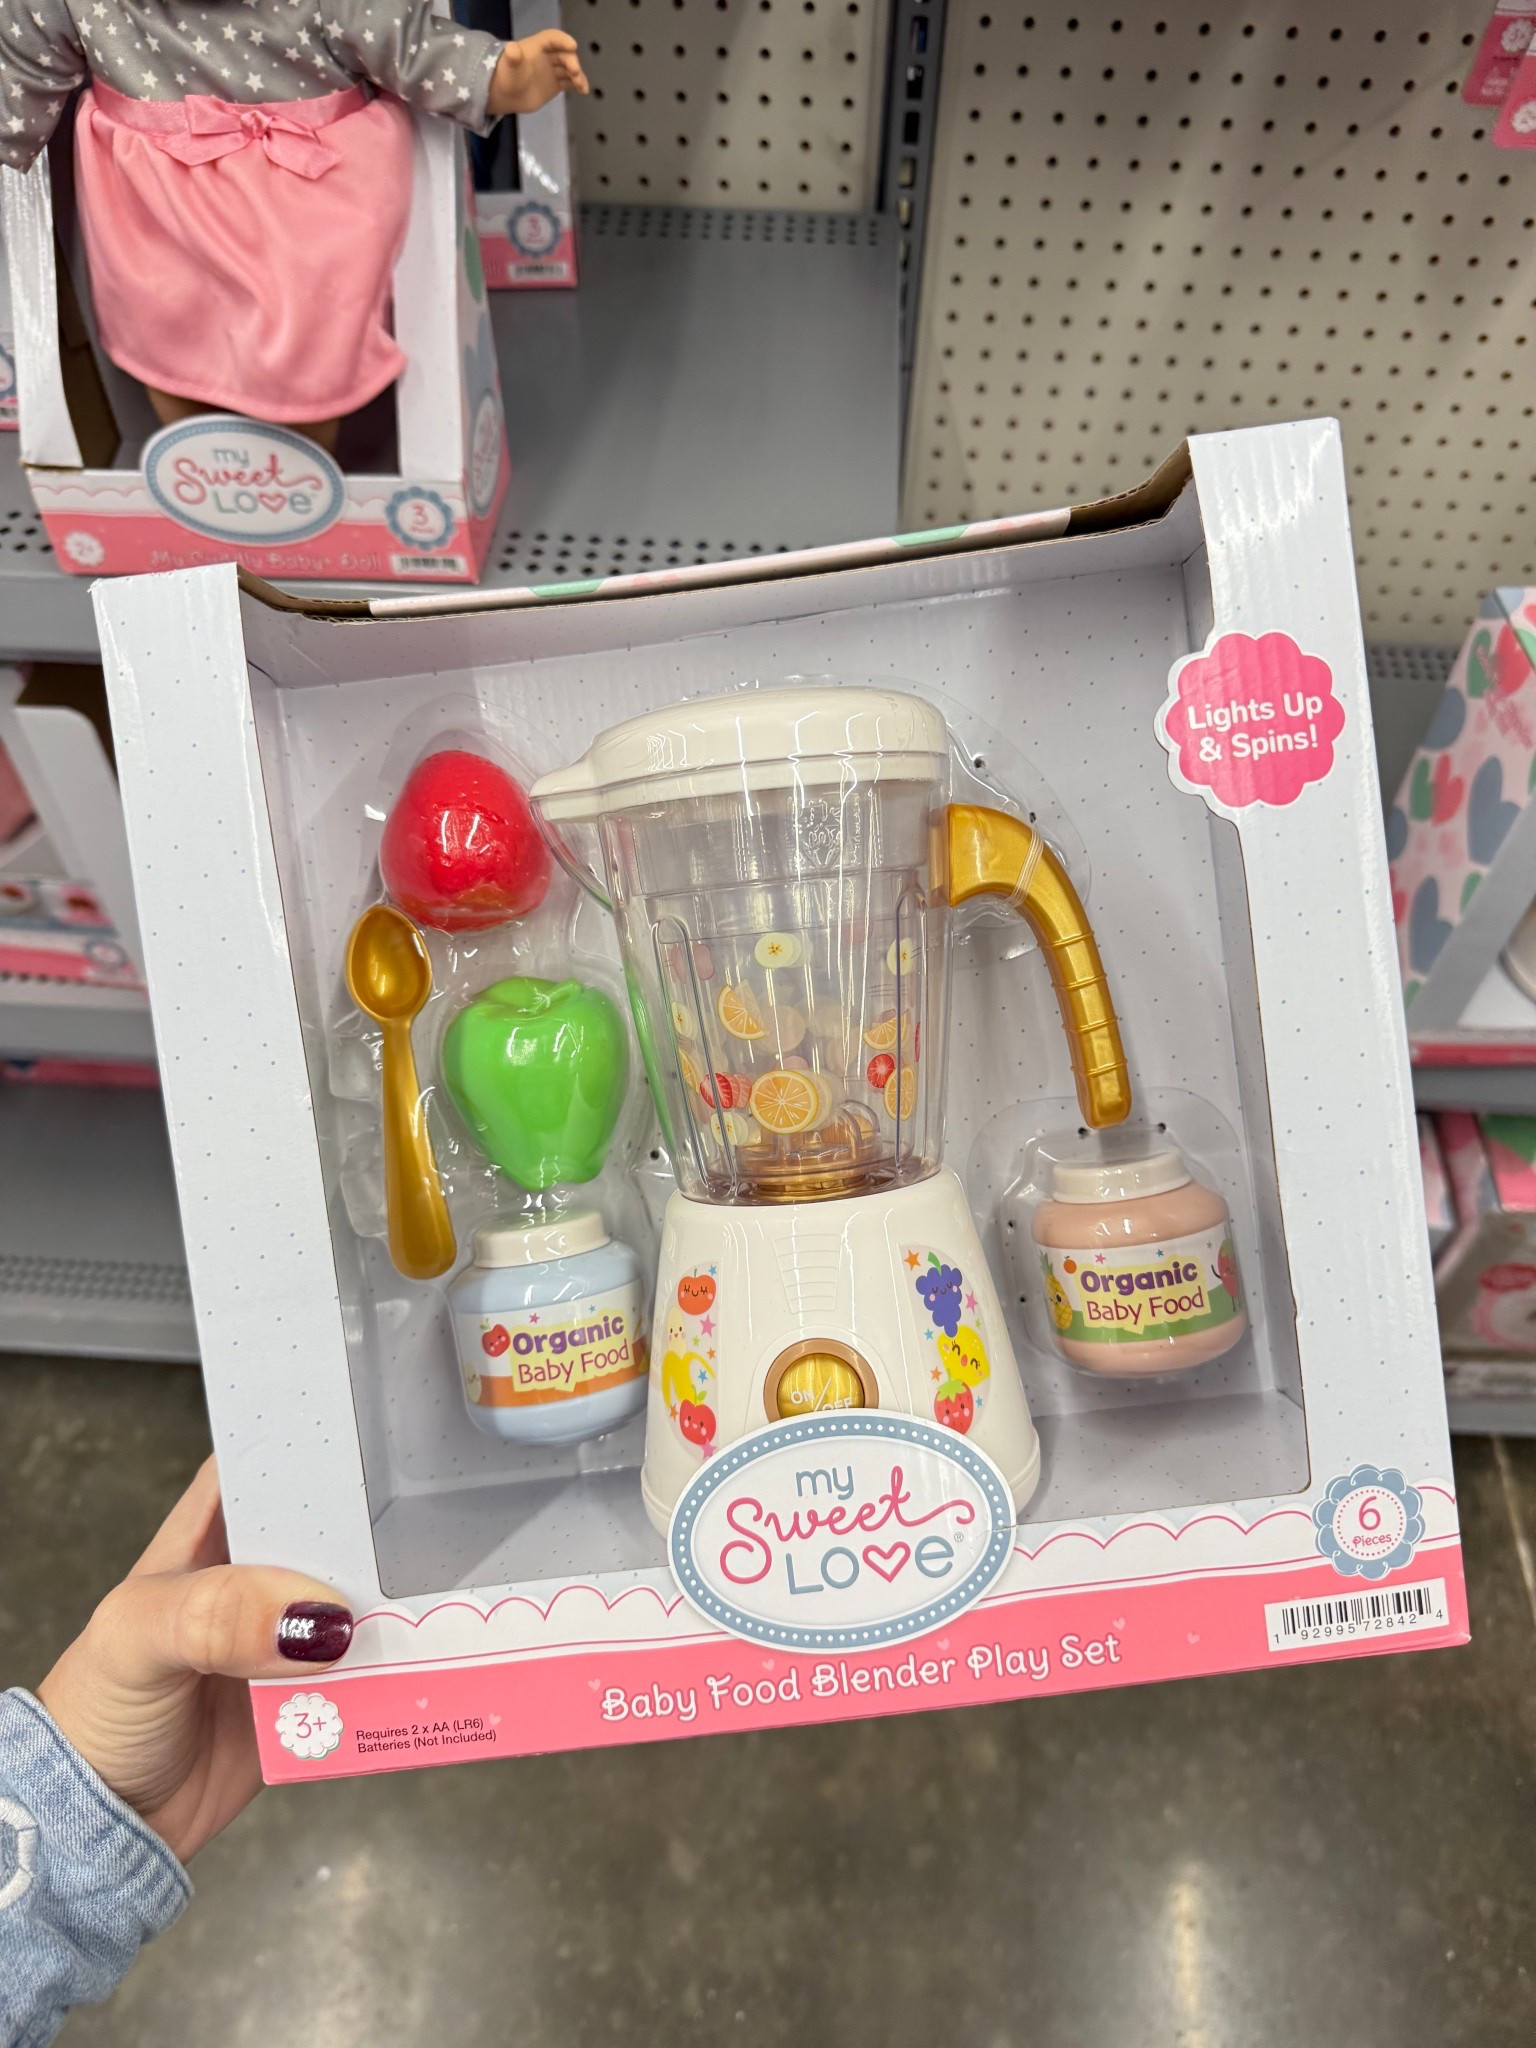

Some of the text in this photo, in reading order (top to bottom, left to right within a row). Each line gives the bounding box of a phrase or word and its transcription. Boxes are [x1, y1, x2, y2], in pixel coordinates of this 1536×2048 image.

[213, 447, 250, 467] my
[173, 452, 323, 505] Sweet
[411, 501, 429, 527] 3
[1187, 691, 1323, 733] Lights Up
[1199, 723, 1318, 762] & Spins!
[1080, 1261, 1198, 1296] Organic
[1086, 1285, 1204, 1325] Baby Food
[512, 1315, 625, 1355] Organic
[518, 1338, 630, 1384] Baby Food
[795, 1465, 855, 1500] my
[719, 1465, 976, 1585] Sweet
[1358, 1495, 1381, 1531] 6
[1352, 1532, 1393, 1548] Pieces
[601, 1633, 1122, 1722] Baby Food Blender Play Set
[294, 1712, 327, 1739] 3+
[356, 1718, 484, 1741] Requires 2 x AA (LR6)
[357, 1729, 497, 1753] Batteries (Not Included)
